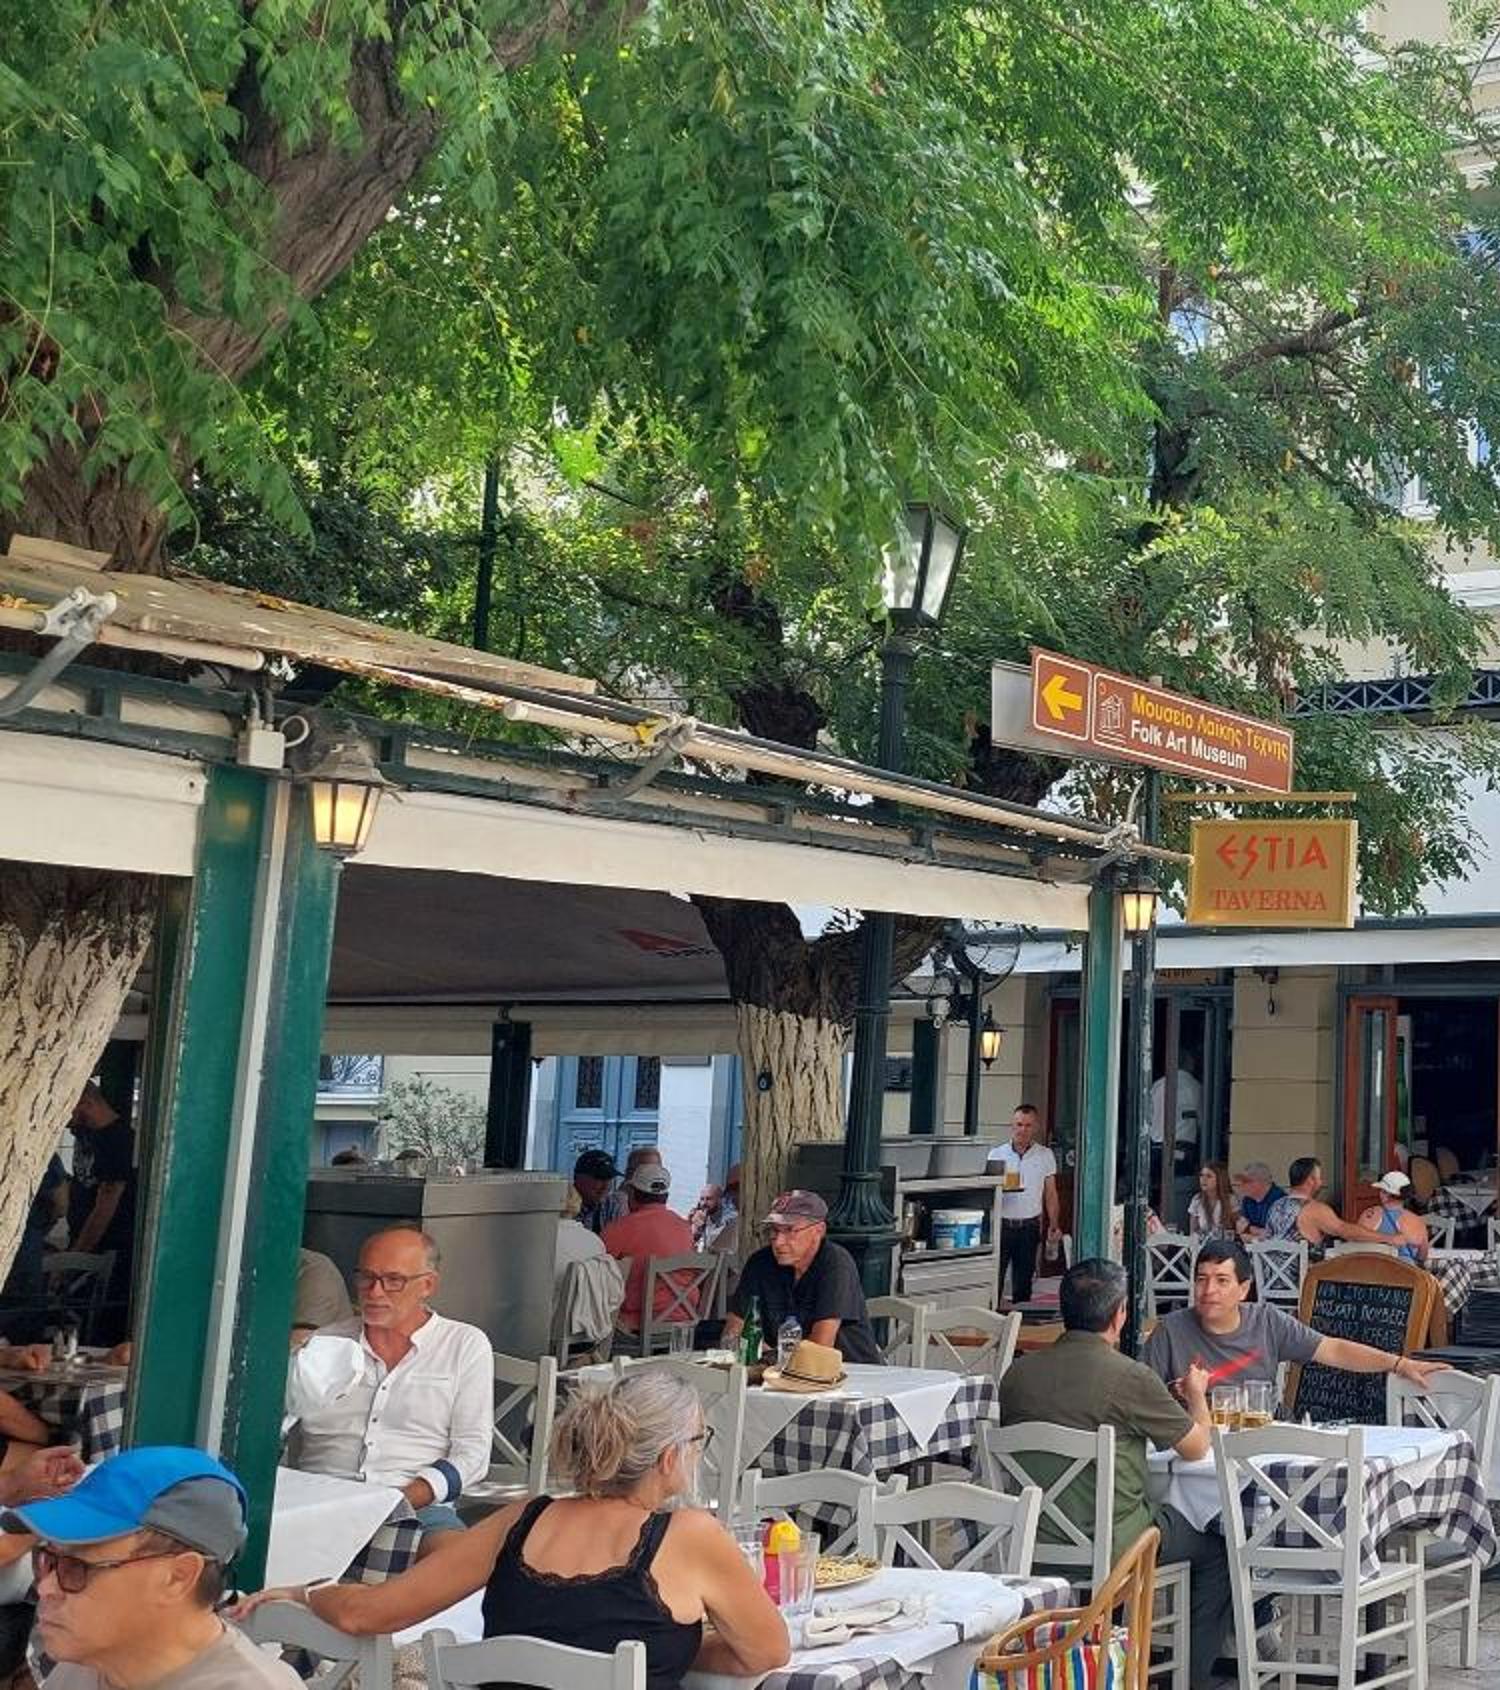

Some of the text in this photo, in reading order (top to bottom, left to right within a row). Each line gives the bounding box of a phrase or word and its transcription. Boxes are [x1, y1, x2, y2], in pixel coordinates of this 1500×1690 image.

[1132, 691, 1193, 728] Μουσείο
[1198, 714, 1242, 748] Λαϊκής
[1131, 719, 1247, 770] Folk Art Museum
[1216, 834, 1329, 880] ESTIA
[1214, 889, 1327, 911] TAVERNA
